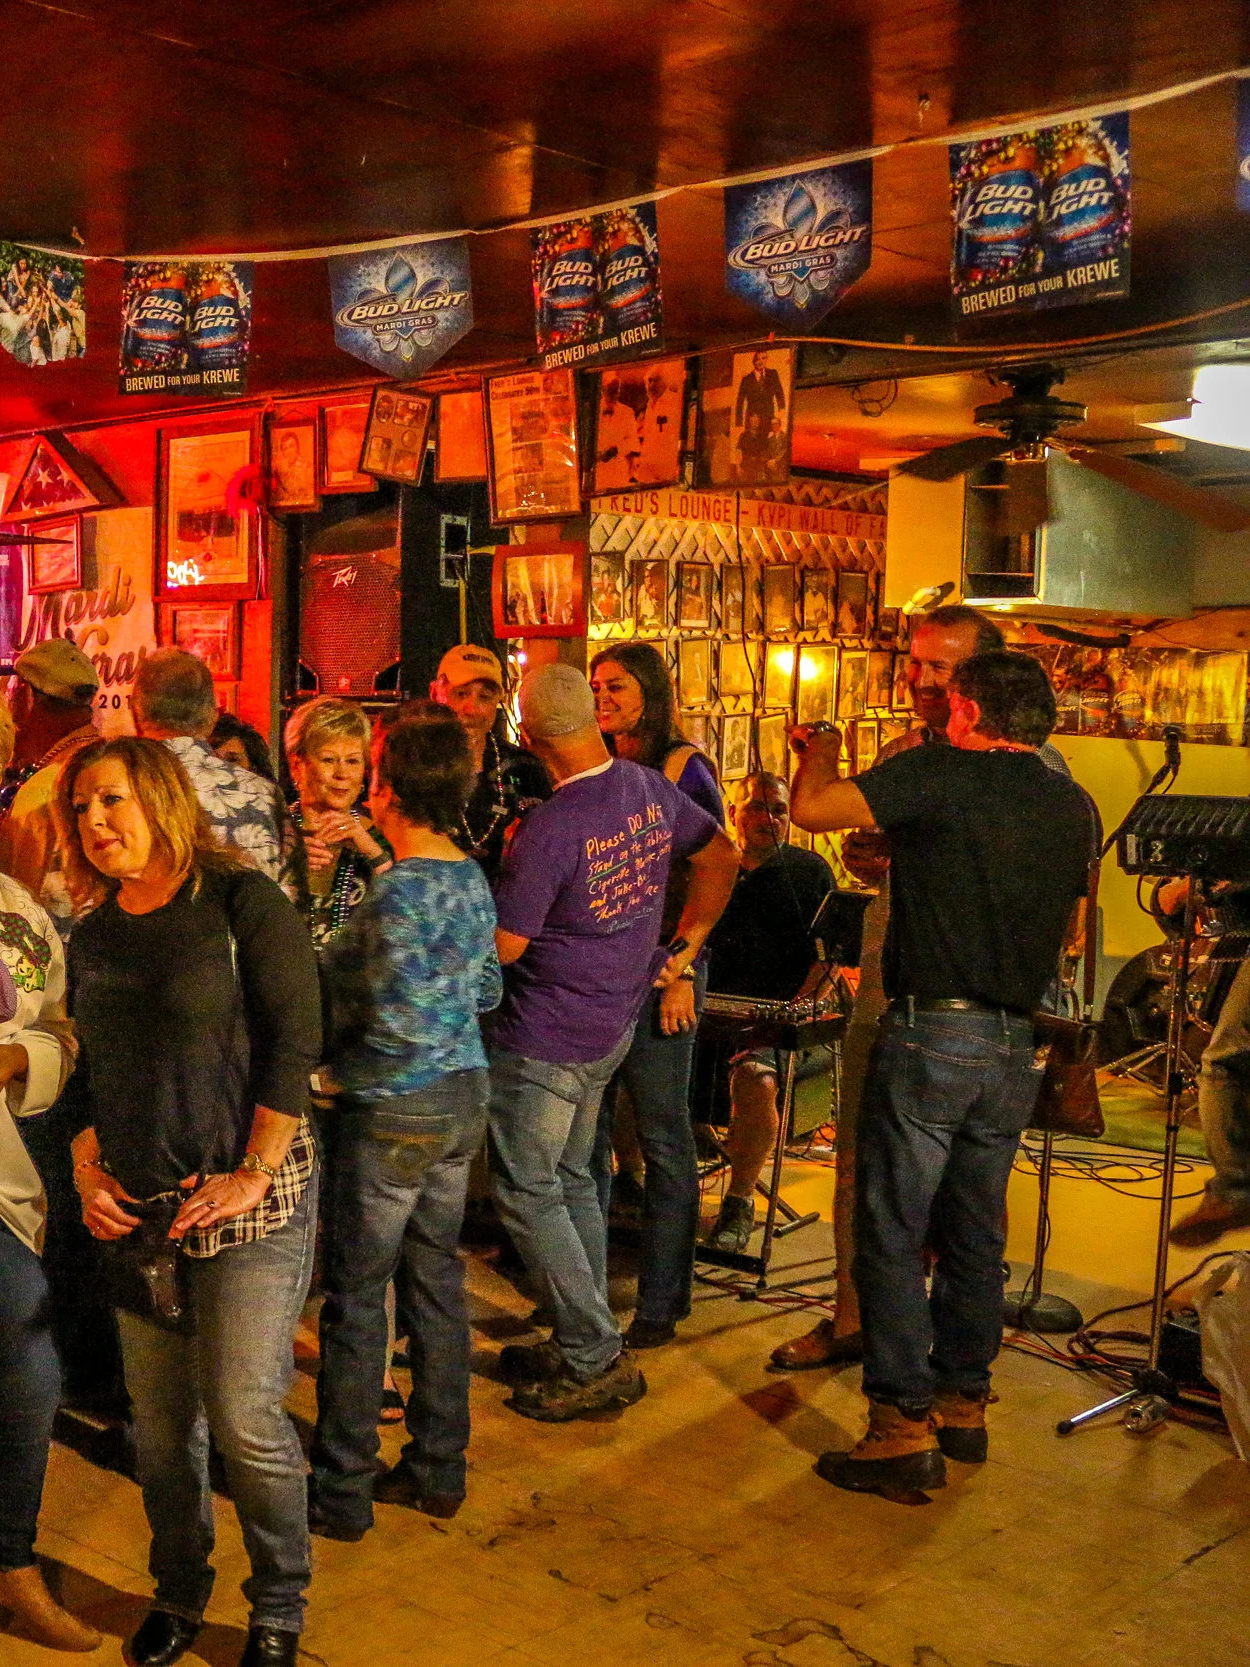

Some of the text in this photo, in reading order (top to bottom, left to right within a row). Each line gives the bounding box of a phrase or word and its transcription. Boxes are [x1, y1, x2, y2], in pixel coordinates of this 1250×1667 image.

[975, 184, 1033, 202] BUD
[1050, 177, 1107, 205] BUD
[963, 200, 1036, 222] LIGHT
[744, 226, 867, 261] BUD LIGHT
[552, 260, 593, 275] BUD
[605, 255, 643, 278] BUD
[770, 255, 831, 274] MARDI GRAS
[544, 273, 596, 291] LIGHT
[961, 258, 1120, 314] BREWED FOR YOUR KREWE
[140, 295, 183, 313] BUD
[193, 306, 235, 321] BUD
[350, 292, 466, 321] BUD LIGHT
[130, 308, 185, 324] LIGHT
[376, 317, 434, 331] MARDI GRAS
[545, 322, 657, 368] BREWED FOR YOUR KREWE
[125, 368, 240, 391] BREWED FOR YOUR KREWE
[598, 492, 659, 515] RED'S
[668, 494, 732, 522] LOUNGE
[845, 513, 862, 535] OF
[12, 567, 136, 651] Mardi
[99, 694, 132, 710] 201
[586, 831, 625, 860] Please
[628, 814, 642, 835] DO
